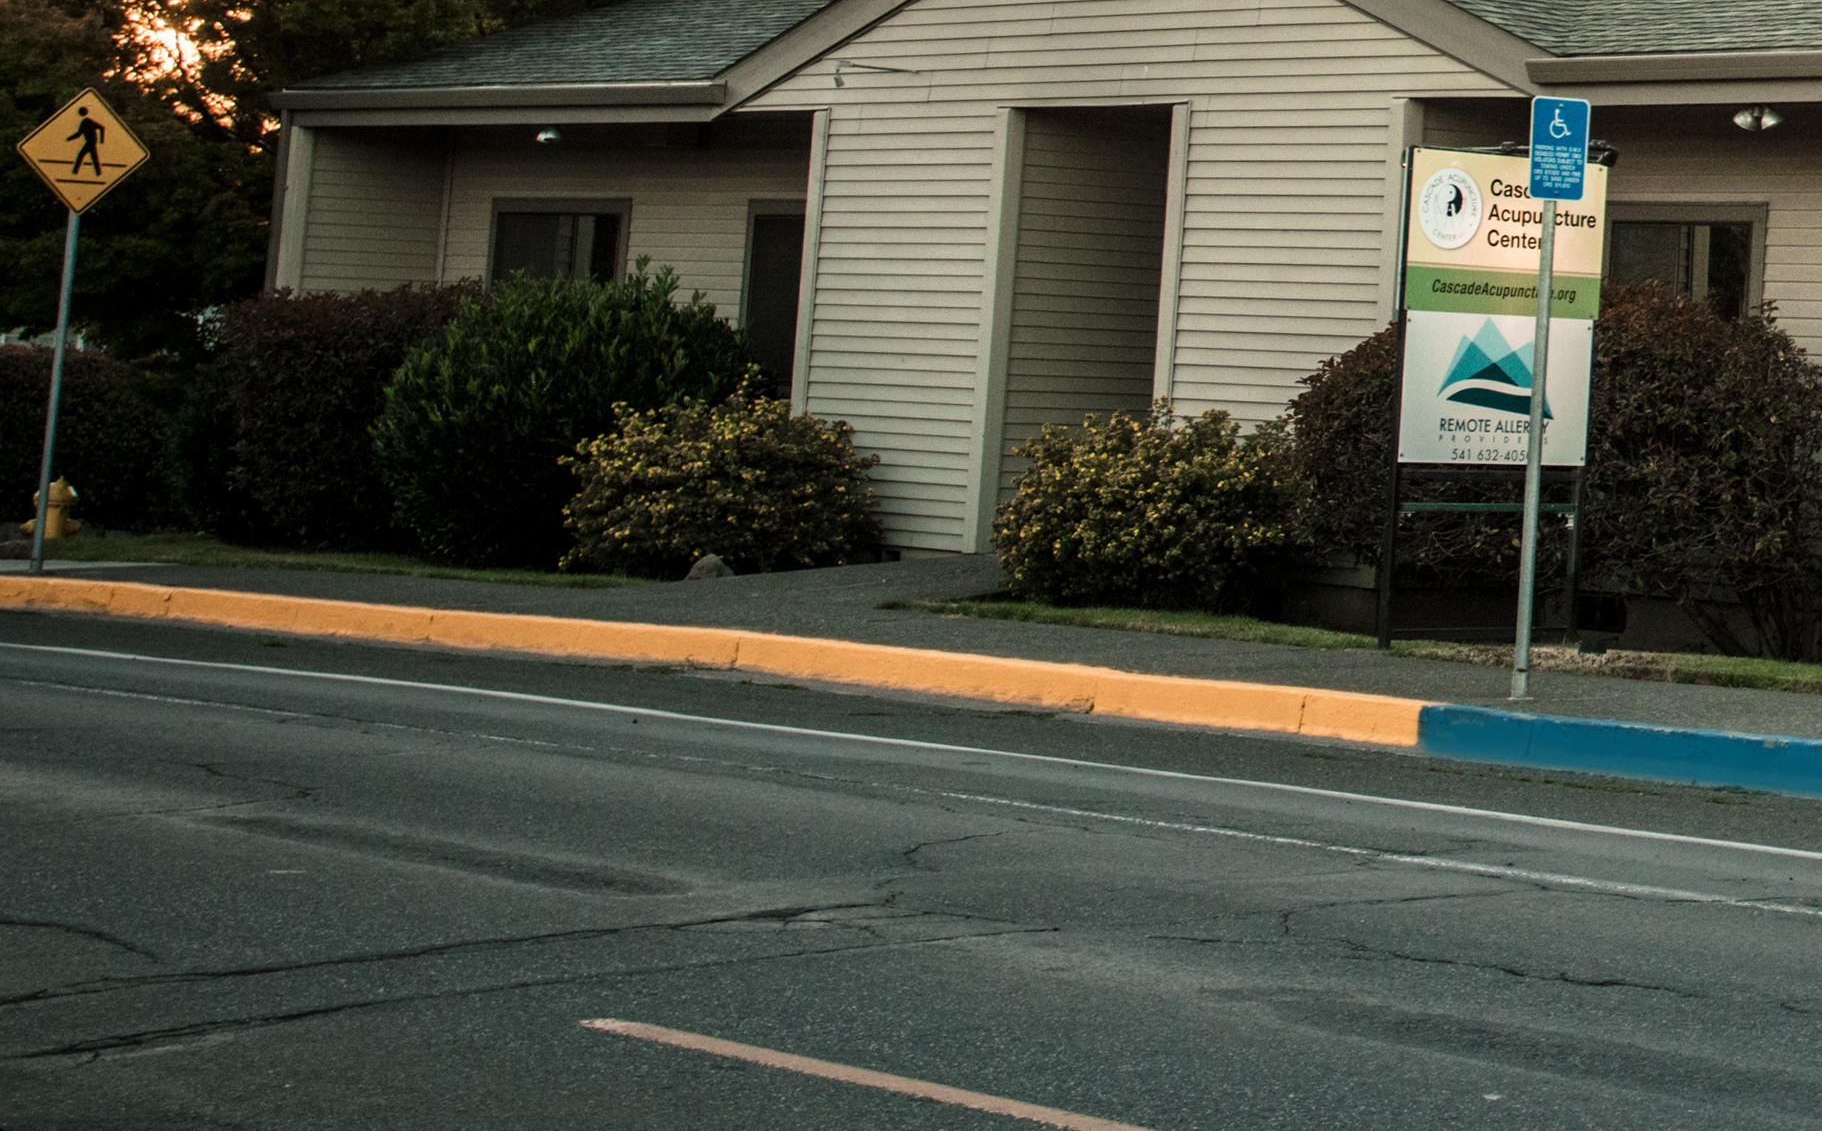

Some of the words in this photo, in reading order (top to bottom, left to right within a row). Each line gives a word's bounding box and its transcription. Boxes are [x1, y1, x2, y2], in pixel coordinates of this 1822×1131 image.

[1422, 174, 1445, 213] CASCADE
[1490, 179, 1531, 199] Casc
[1488, 204, 1597, 229] Acupucture
[1432, 279, 1577, 304] CascadeAcupunct.org
[1440, 418, 1491, 433] REMOTE
[1494, 420, 1549, 434] ALLERY
[1439, 434, 1549, 445] PROVIDES
[1451, 449, 1471, 461] 541
